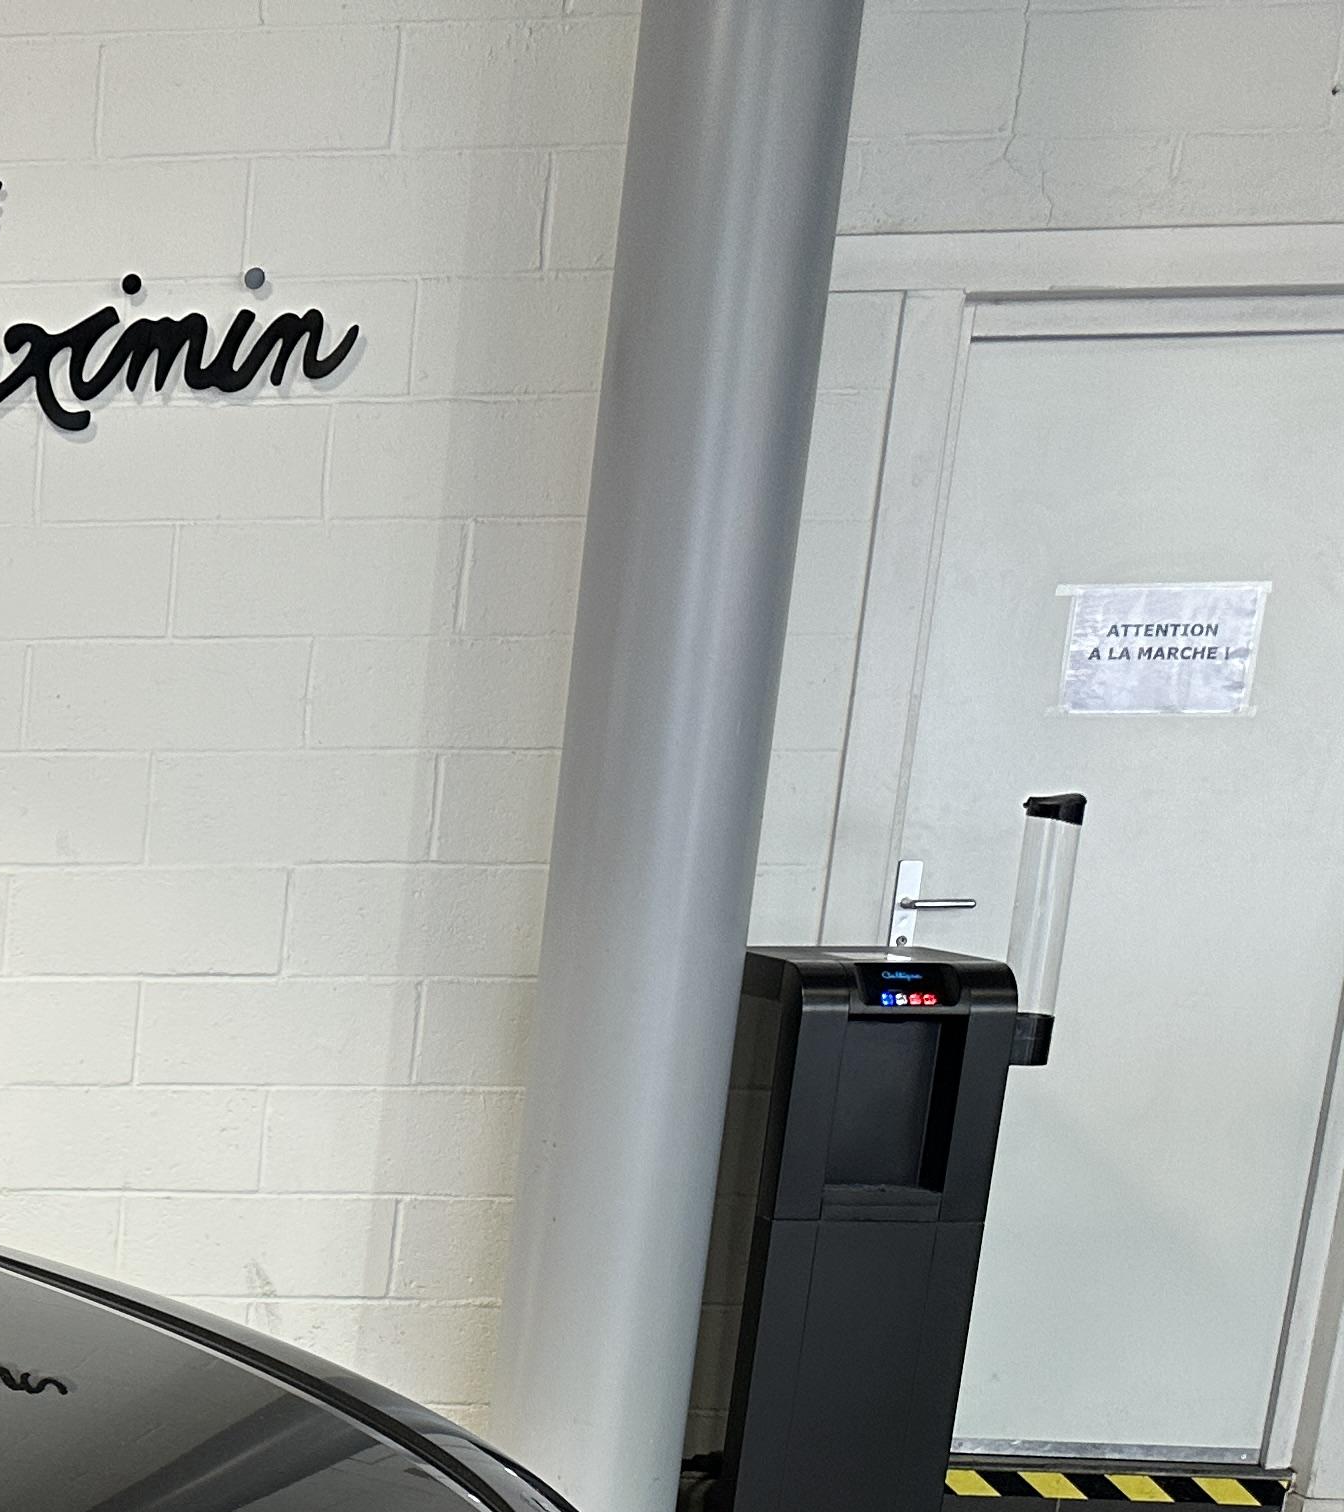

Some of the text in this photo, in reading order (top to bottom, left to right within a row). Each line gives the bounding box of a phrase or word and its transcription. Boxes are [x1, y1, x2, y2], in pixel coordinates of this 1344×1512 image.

[1106, 623, 1219, 638] ATTENTION
[1088, 646, 1101, 660] A
[1107, 646, 1131, 660] LA
[1137, 646, 1218, 660] MARCHE
